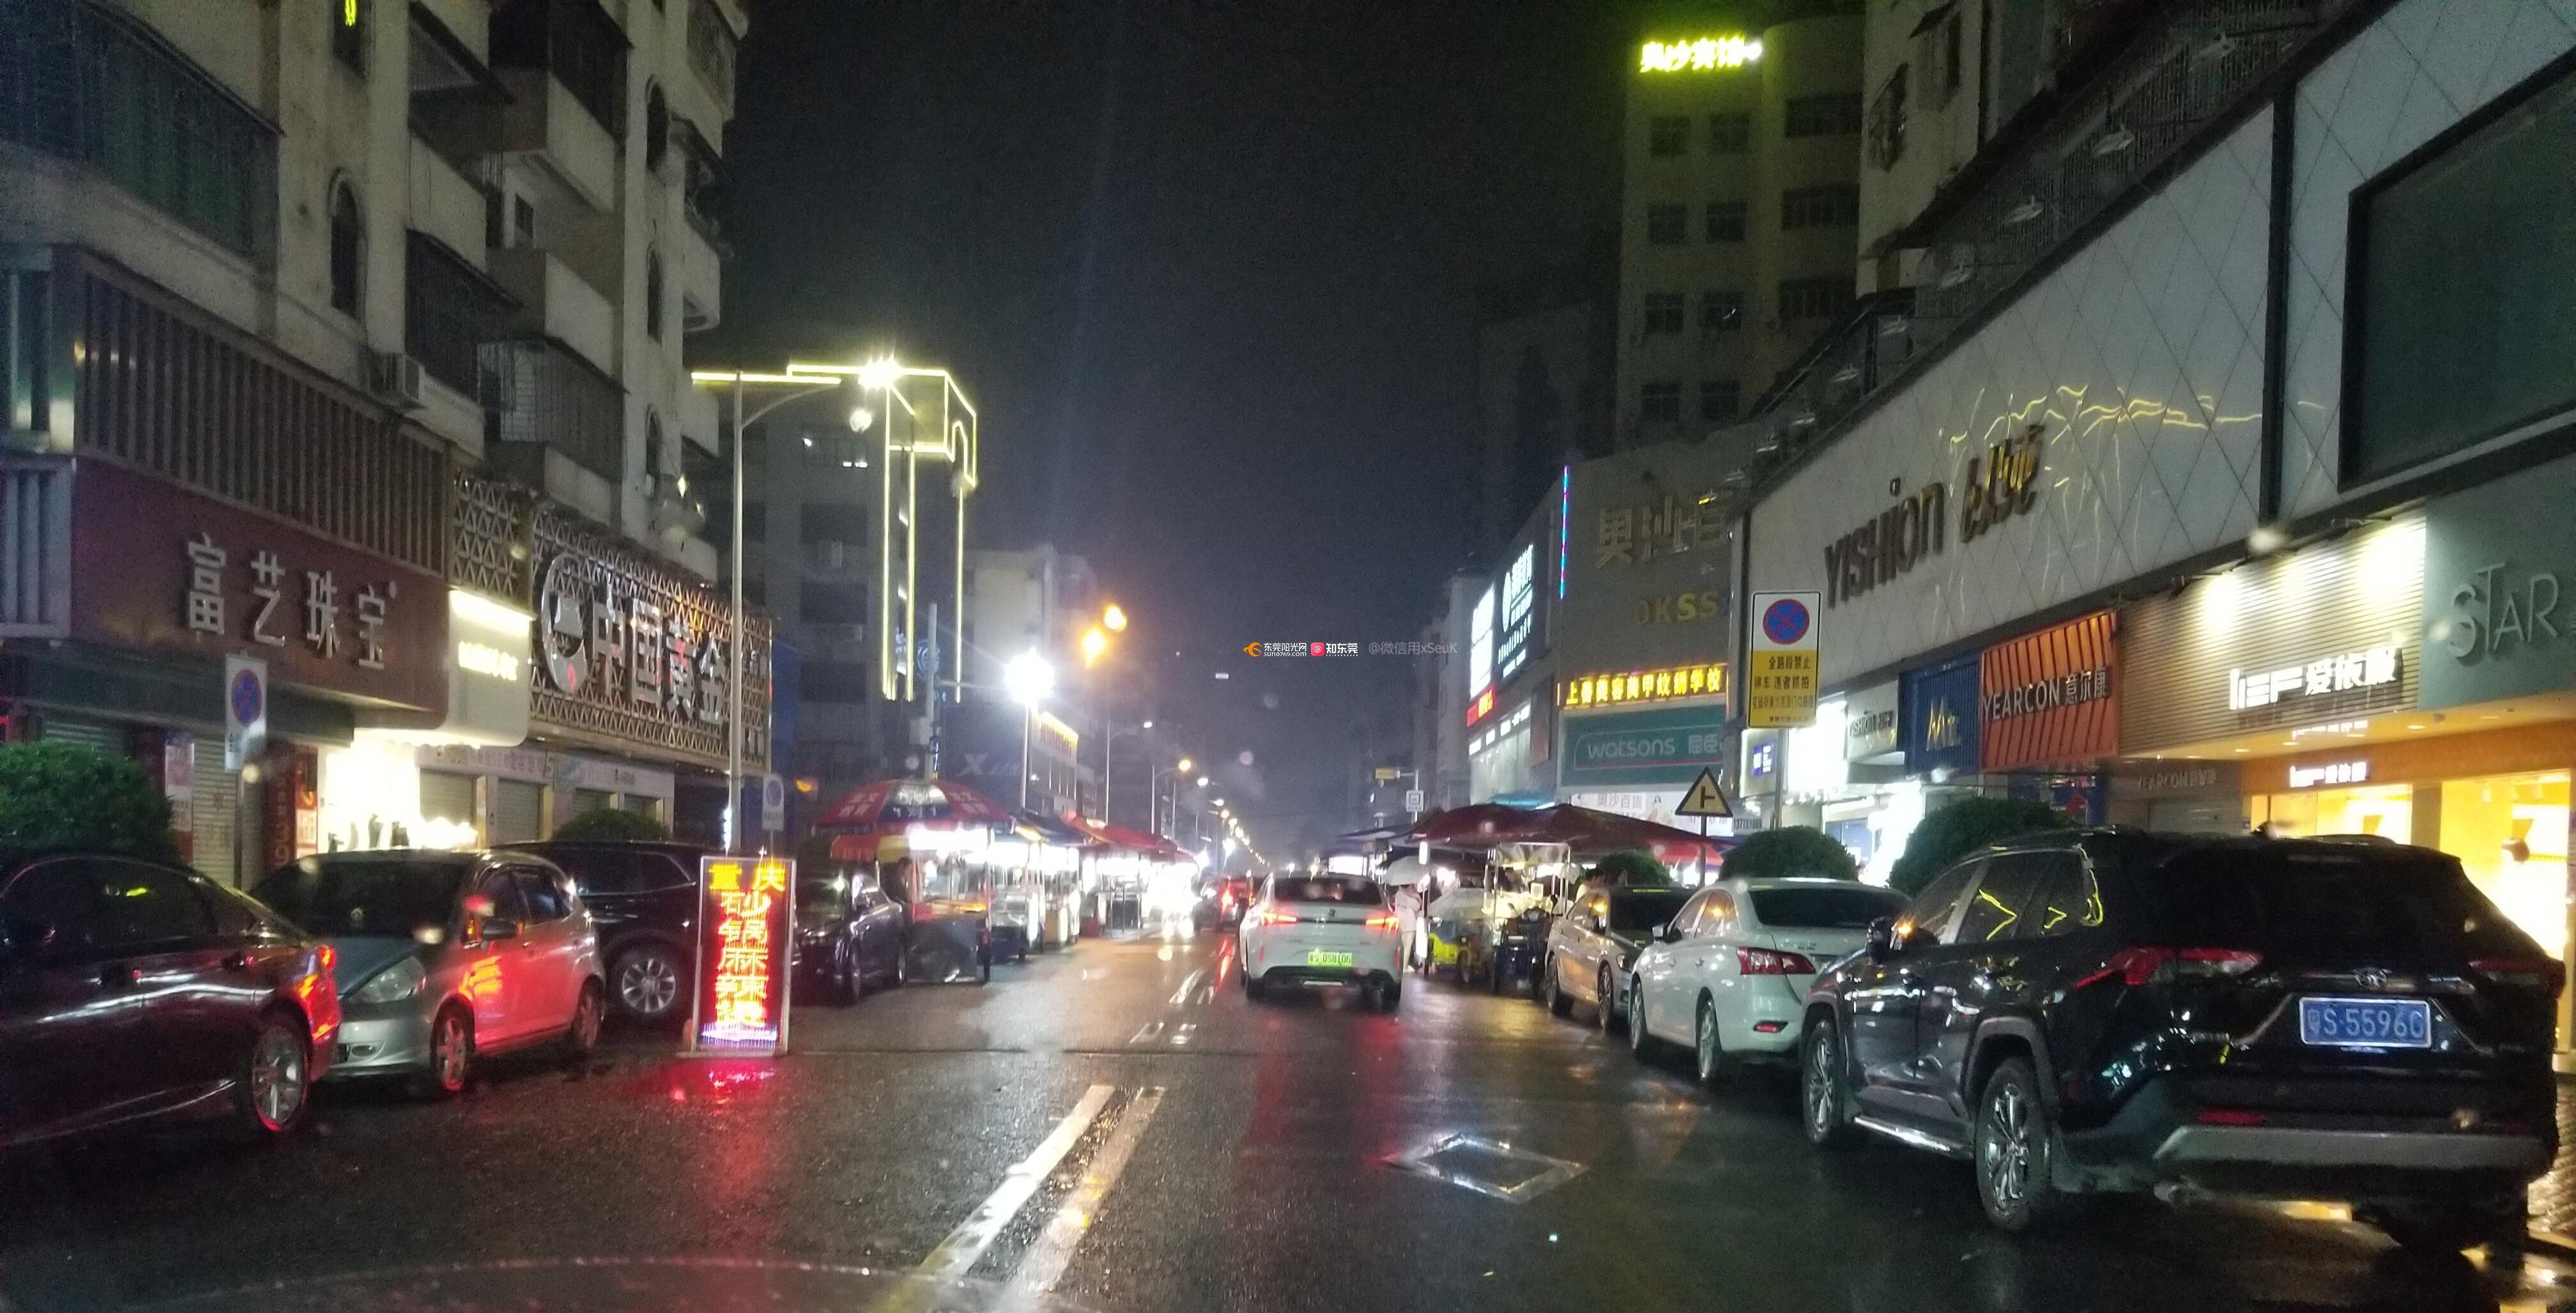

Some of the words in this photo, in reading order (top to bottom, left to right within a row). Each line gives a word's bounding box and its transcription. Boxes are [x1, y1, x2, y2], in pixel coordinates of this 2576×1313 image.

[188, 532, 385, 670] 富艺珠宝
[2448, 562, 2559, 658] STAR
[593, 571, 729, 725] 中国黄金
[1977, 677, 2060, 723] YEARCON
[2066, 666, 2107, 703] 意尔康
[1588, 737, 1675, 759] watsons
[709, 860, 785, 892] 重庆
